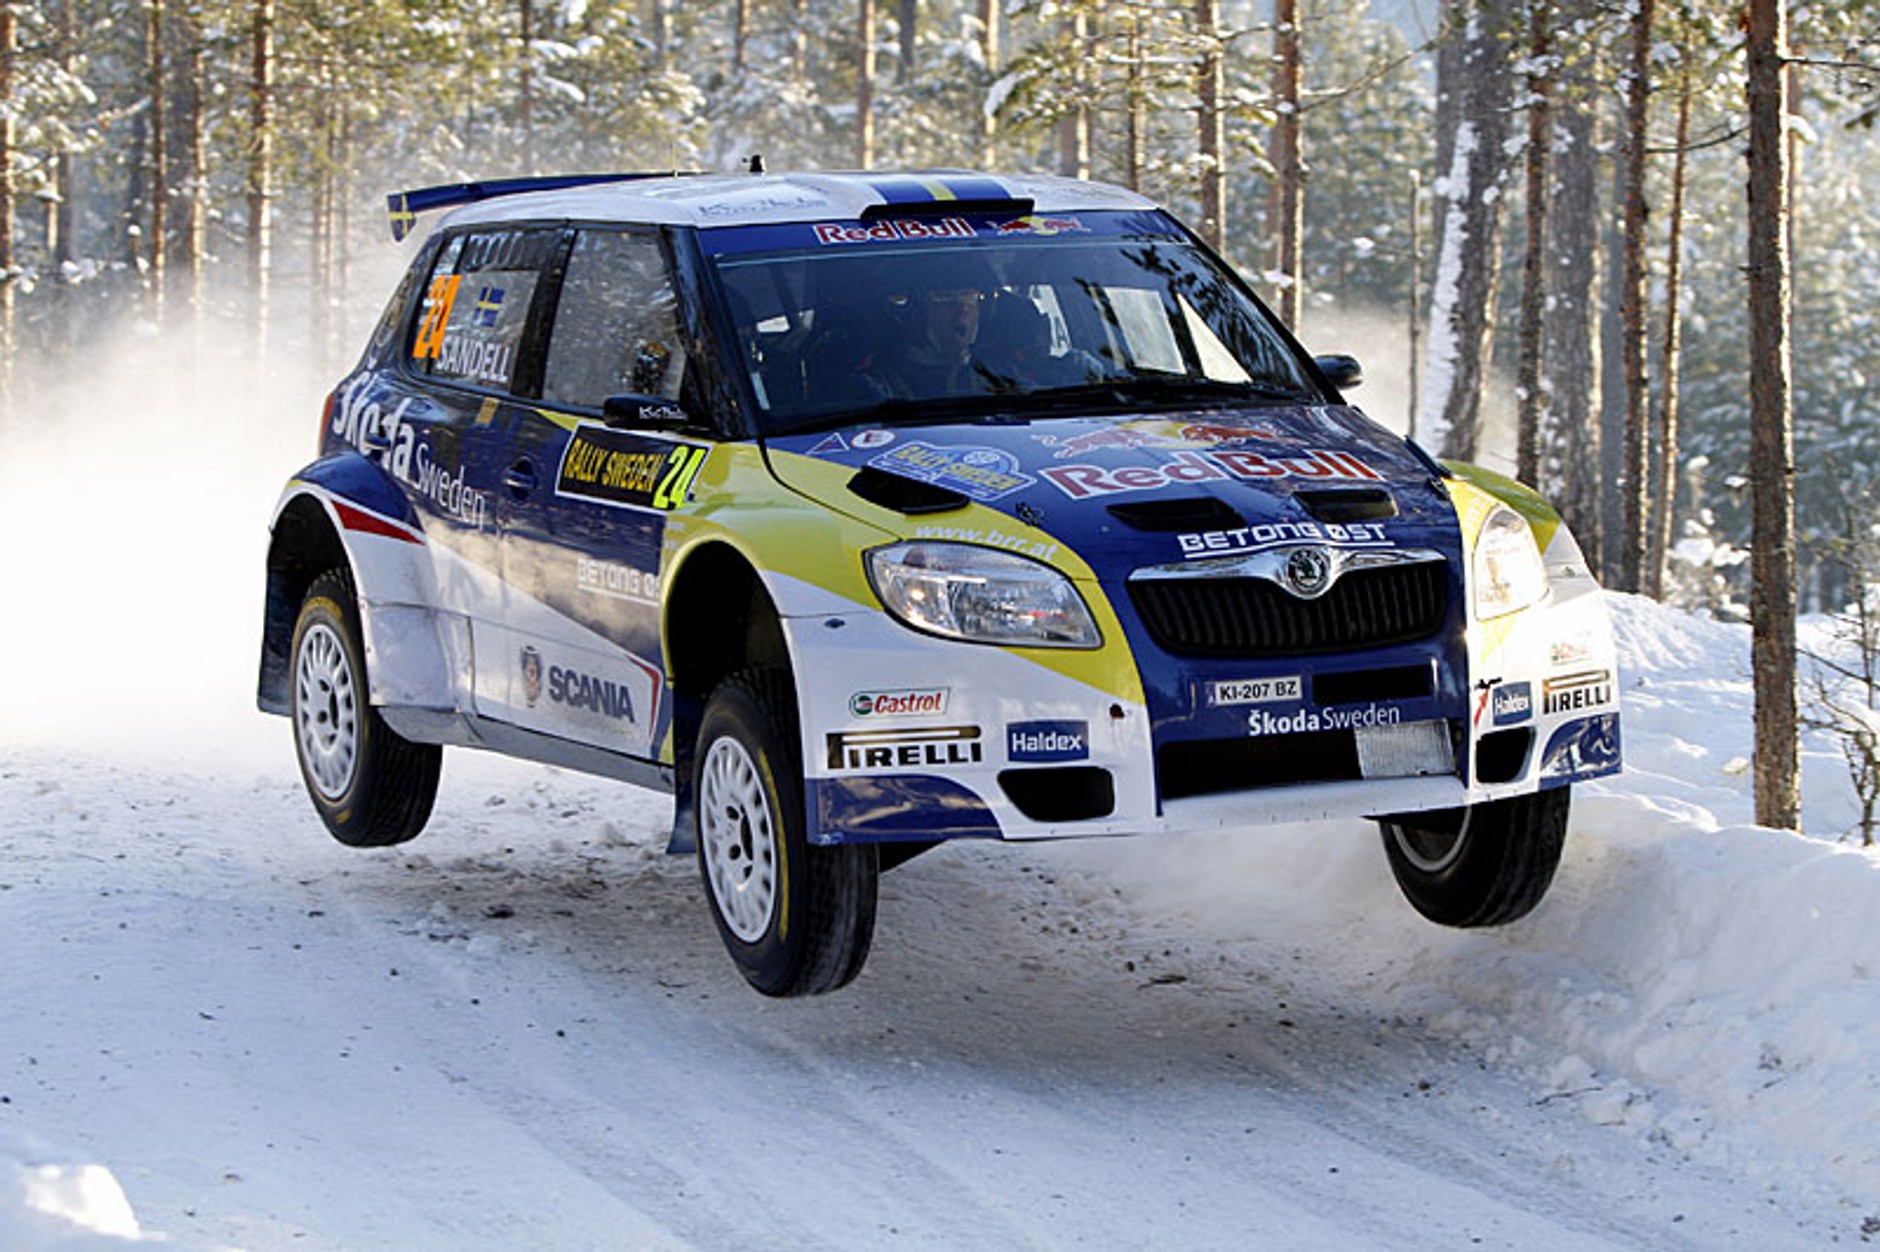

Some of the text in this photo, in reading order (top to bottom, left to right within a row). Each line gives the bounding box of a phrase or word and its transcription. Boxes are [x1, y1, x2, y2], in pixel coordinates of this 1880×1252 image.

[812, 216, 979, 245] Red Bull
[436, 335, 511, 382] SANDELL
[415, 443, 486, 531] Sweden
[564, 437, 706, 509] RALLY SWEDEN 24
[1037, 452, 1230, 500] Red
[1205, 449, 1387, 481] Bull
[916, 526, 1058, 560] www.brr.at
[1177, 523, 1322, 551] BETONG
[578, 557, 641, 595] BETONG
[548, 665, 635, 723] SCANIA
[874, 692, 942, 714] Castrol
[1275, 681, 1297, 697] BZ
[1541, 669, 1610, 715] PIRELLI
[1249, 703, 1400, 736] Škoda Sweden
[826, 726, 982, 769] PIRELLI
[1012, 731, 1083, 753] Haldex
